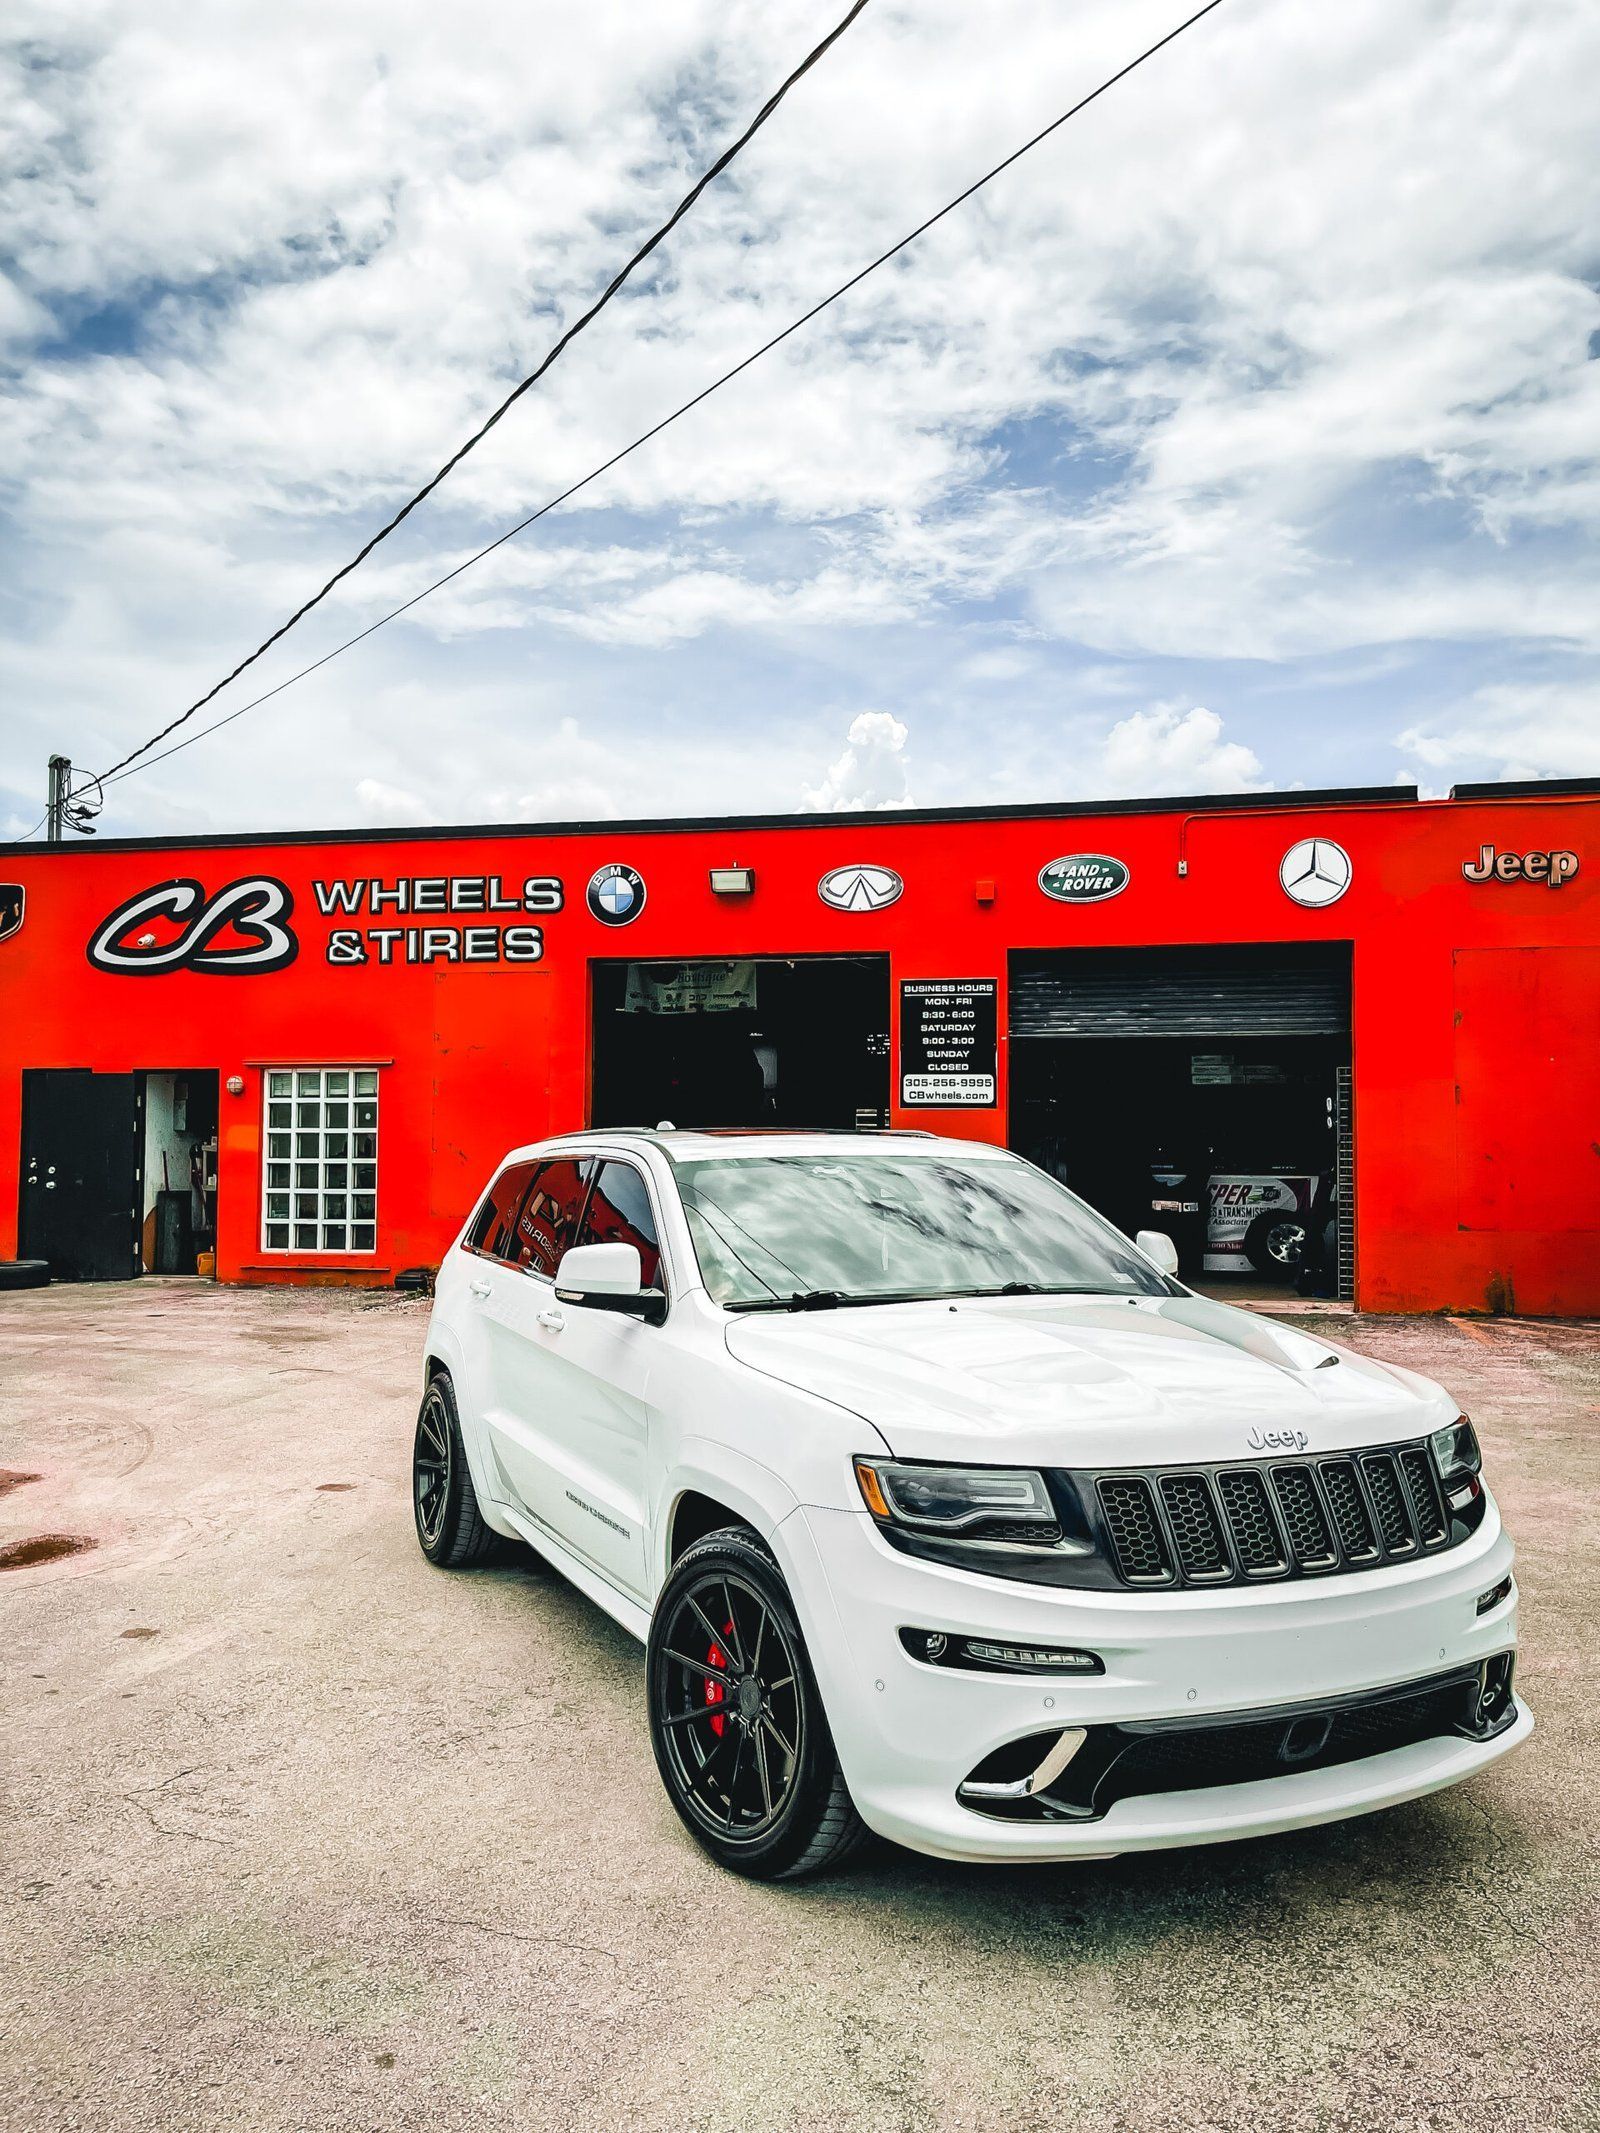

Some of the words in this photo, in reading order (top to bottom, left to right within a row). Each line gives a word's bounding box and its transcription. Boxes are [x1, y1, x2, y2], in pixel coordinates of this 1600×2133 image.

[1462, 844, 1579, 887] Jeep
[593, 866, 639, 886] BMW
[1058, 865, 1100, 878] LAND
[1062, 877, 1114, 891] ROVER
[313, 877, 564, 916] WHEELS
[89, 877, 296, 973] CB
[904, 985, 955, 993] BUSINESS
[957, 984, 993, 992] HOURS
[921, 1024, 976, 1032] SATURDAY
[952, 1037, 975, 1045] 3:00
[927, 1050, 970, 1058] SUNDAY
[928, 1063, 969, 1071] CLOSED
[905, 1078, 992, 1087] 305-256-9995
[909, 1091, 989, 1100] CBwheels.com
[1212, 1217, 1248, 1226] Associate
[1246, 1425, 1309, 1452] Jeep
